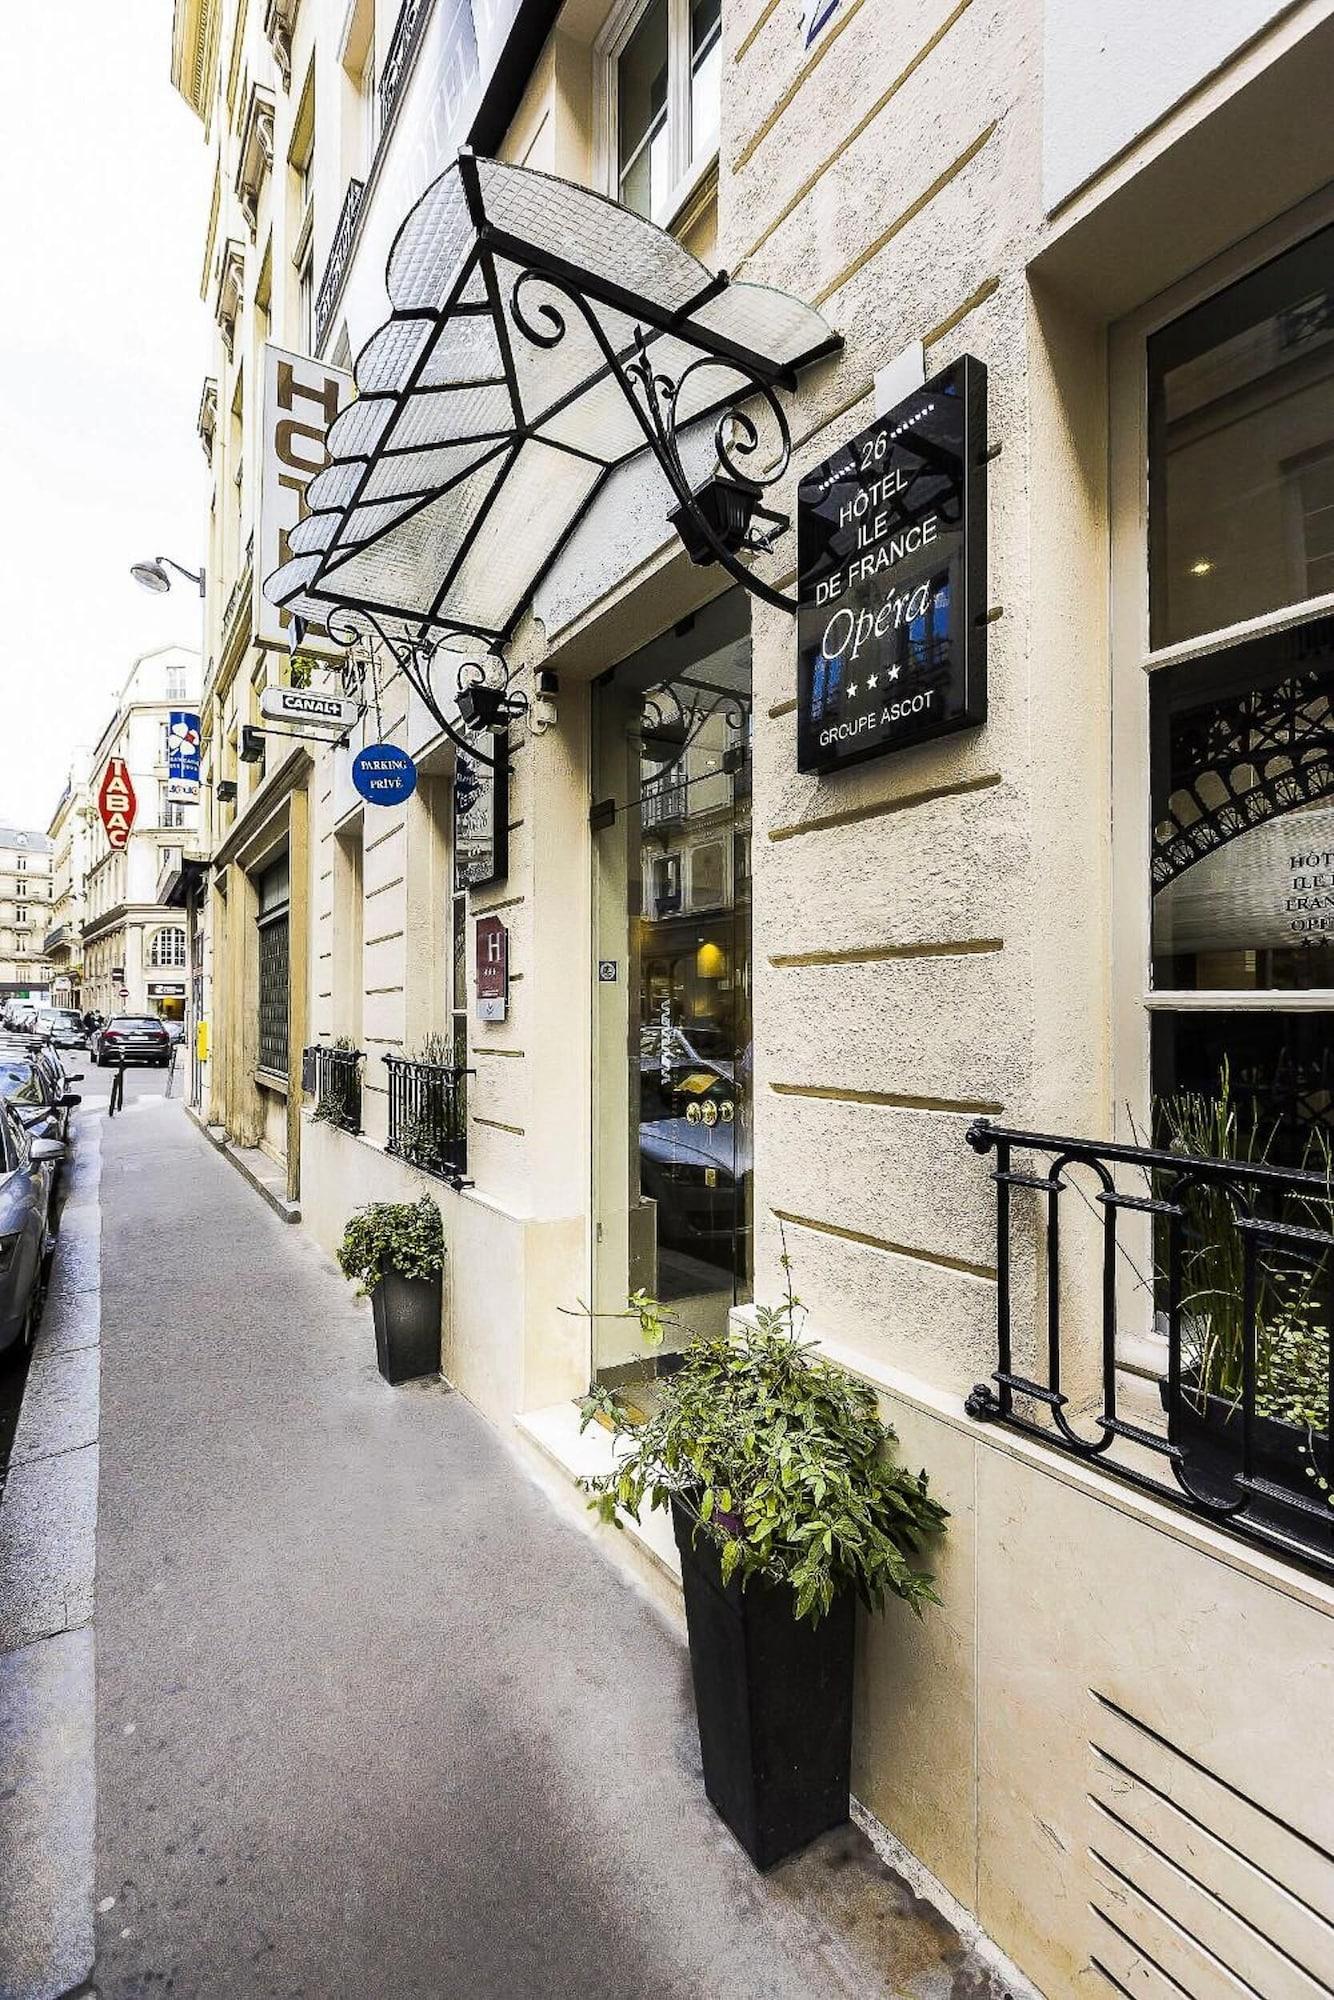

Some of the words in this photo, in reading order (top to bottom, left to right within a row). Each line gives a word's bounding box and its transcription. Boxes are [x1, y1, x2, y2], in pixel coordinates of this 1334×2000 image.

[859, 431, 889, 471] 26
[838, 467, 909, 529] HÔTEL
[856, 511, 888, 550] ILE
[815, 577, 841, 608] DE
[847, 515, 939, 593] FRANCE
[821, 578, 932, 661] Opéra
[284, 697, 340, 714] CANAL+
[818, 708, 877, 748] GROUPE
[880, 689, 935, 727] ASCOT
[361, 760, 407, 770] PARKING
[370, 777, 403, 789] PRIVÉ
[105, 760, 129, 847] TABAC
